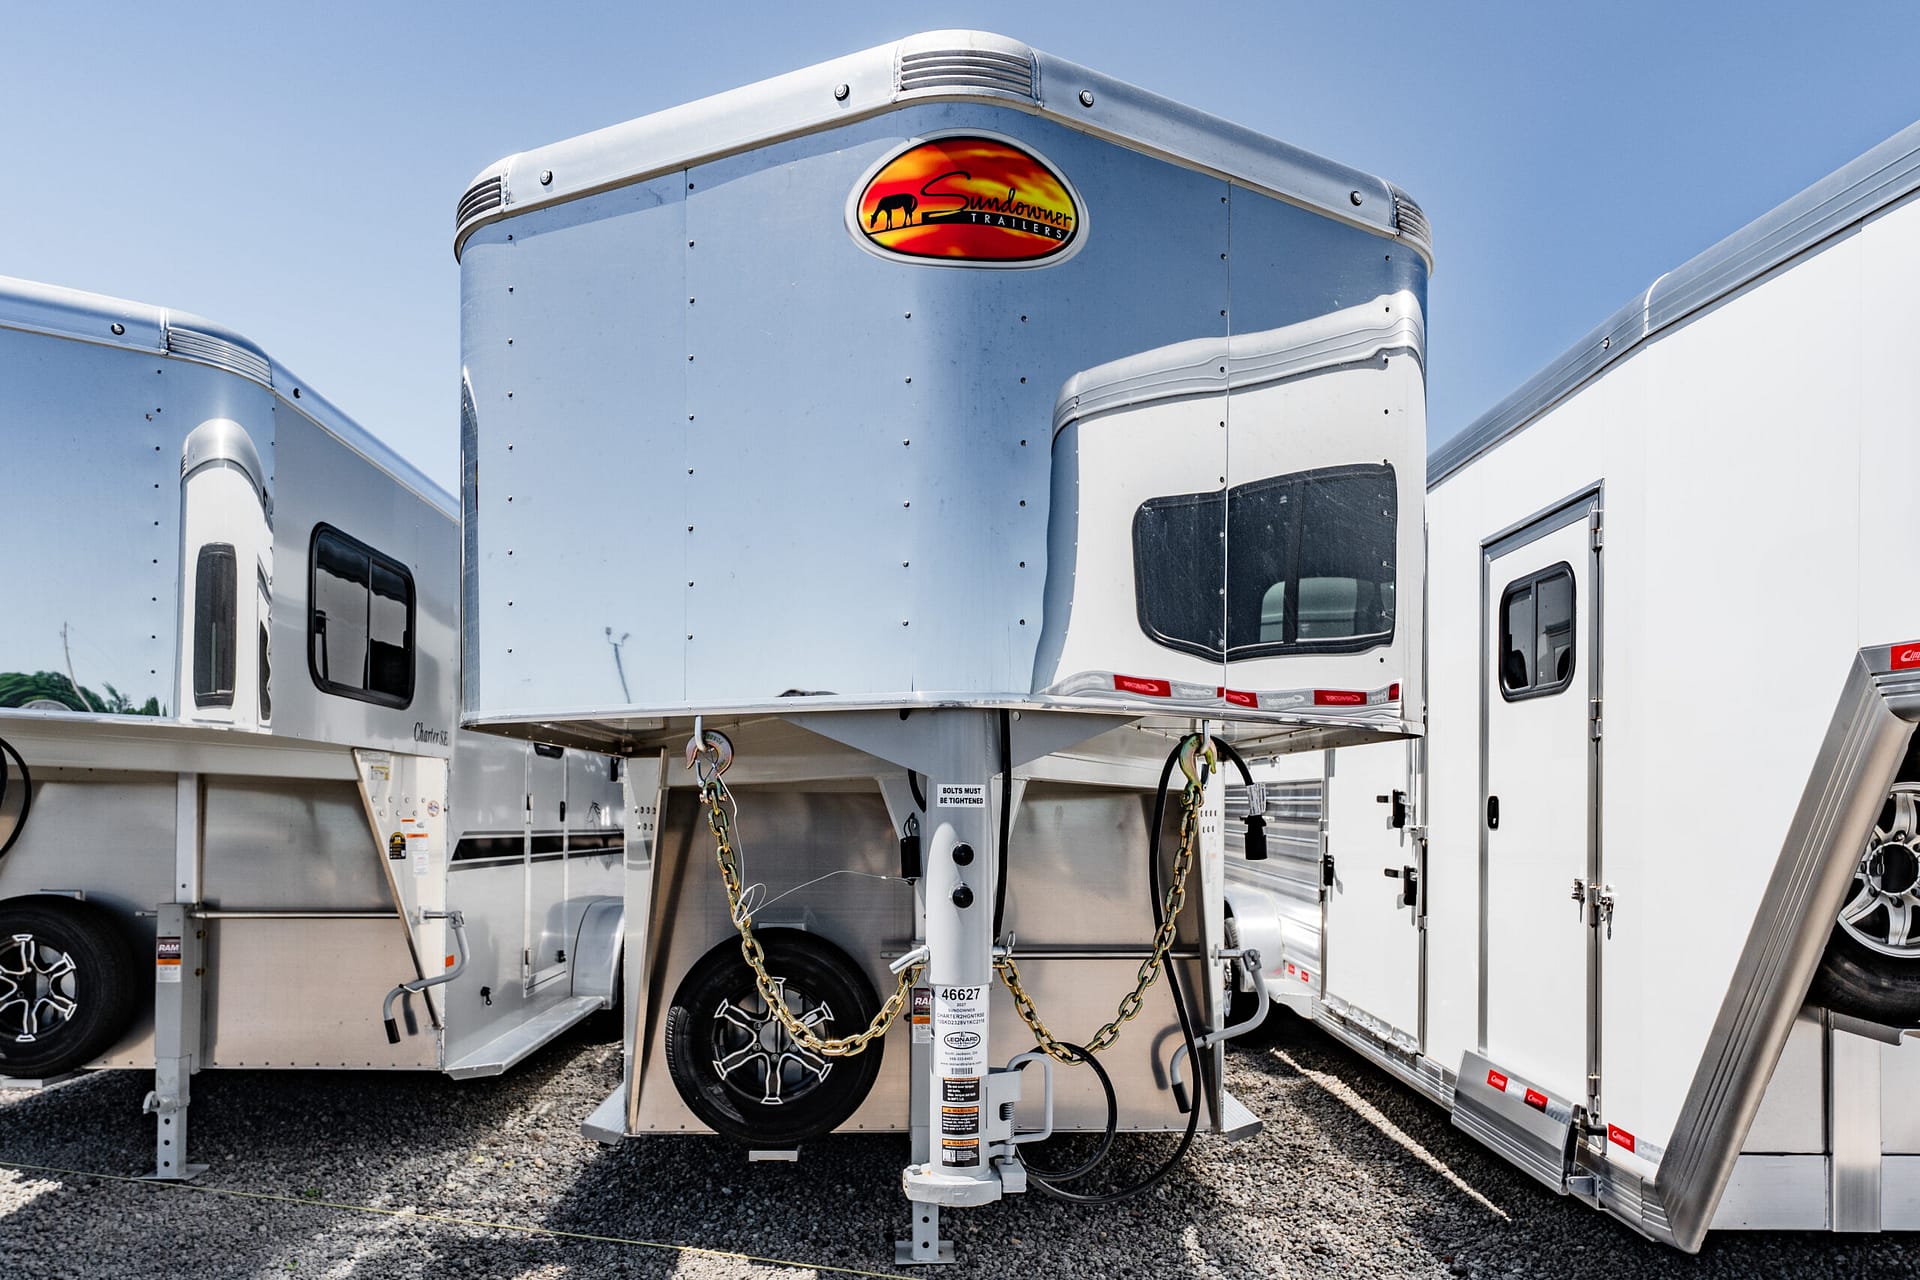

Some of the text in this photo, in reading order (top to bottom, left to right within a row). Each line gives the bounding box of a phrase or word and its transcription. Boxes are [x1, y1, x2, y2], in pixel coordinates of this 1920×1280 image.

[920, 171, 1072, 227] Sundowner
[970, 213, 1063, 239] TRAILERS
[414, 721, 448, 747] Charter SE
[941, 988, 980, 1001] 46627
